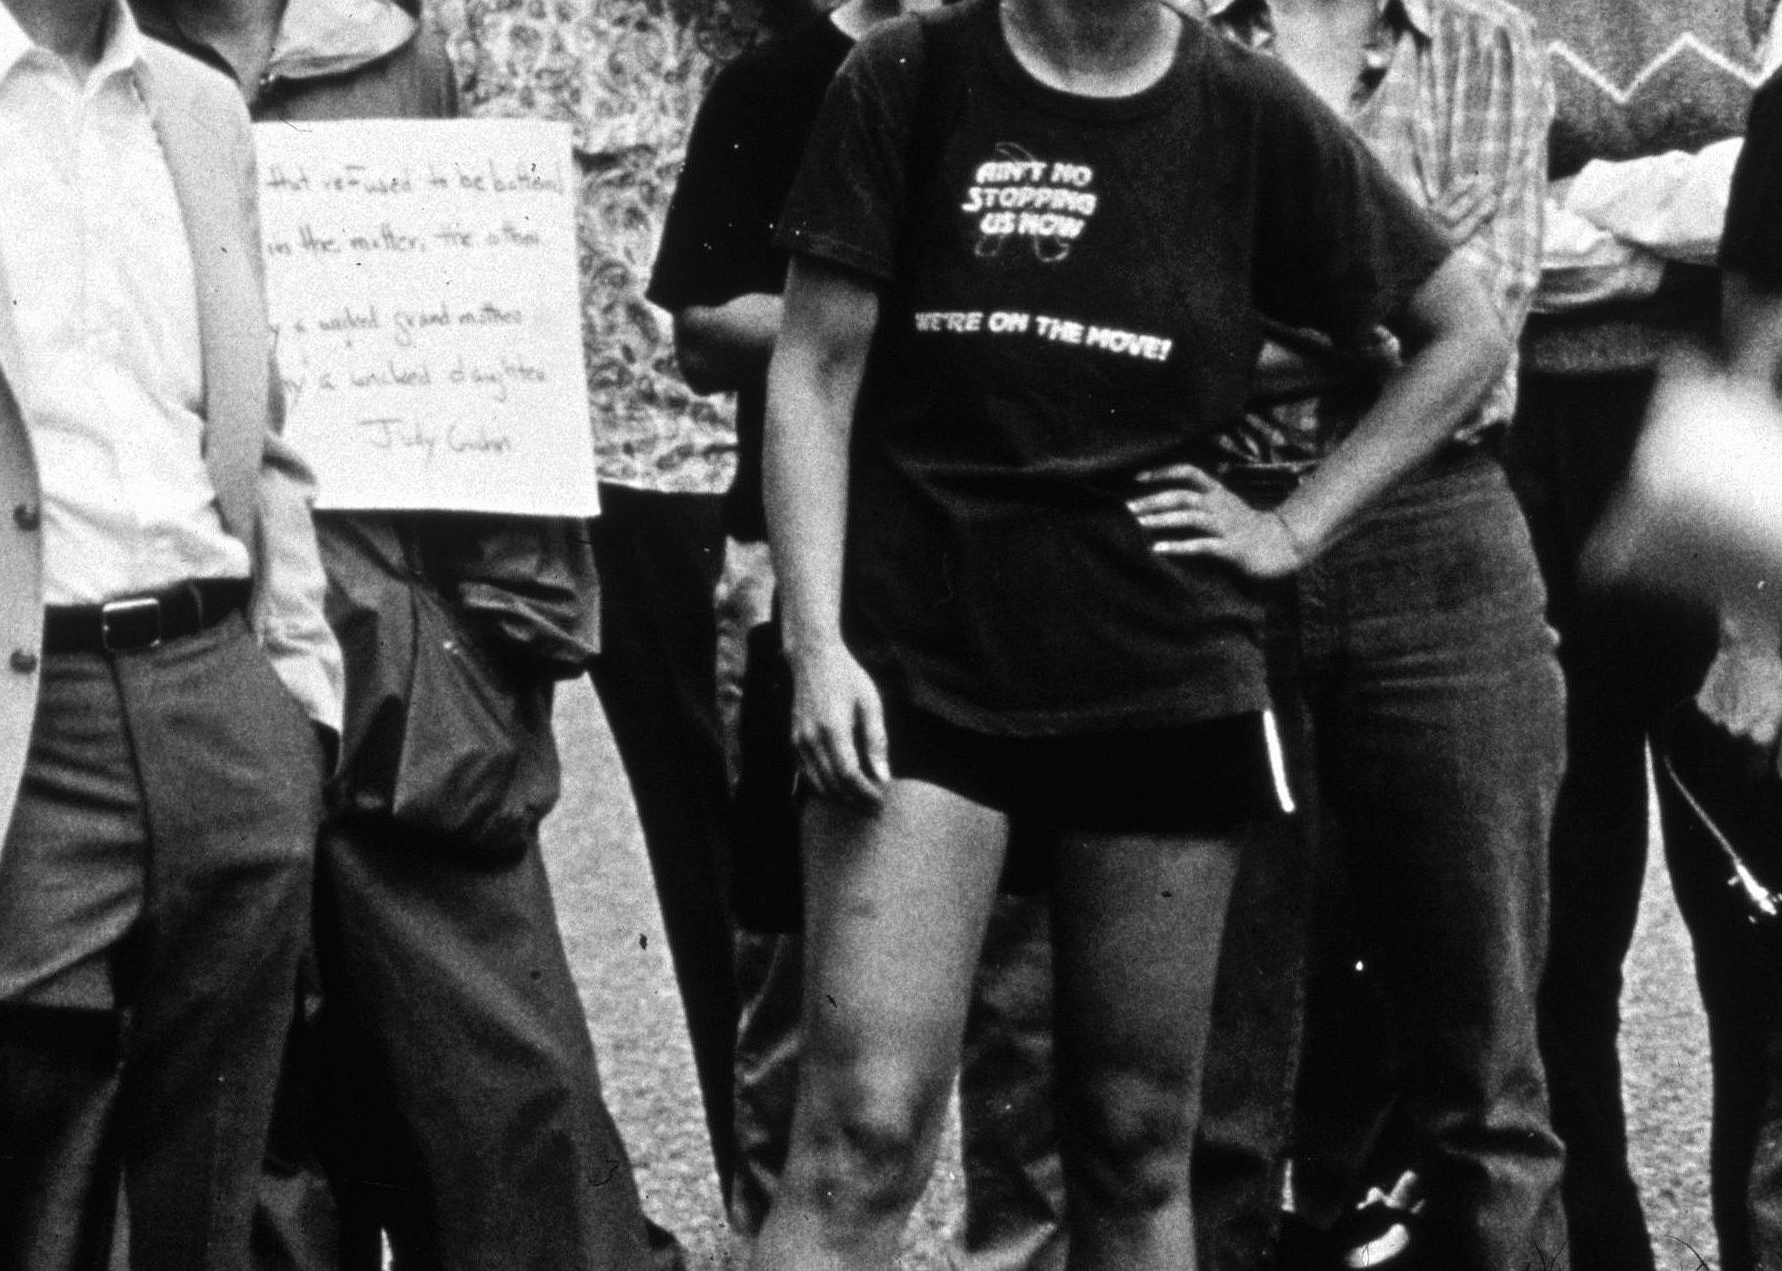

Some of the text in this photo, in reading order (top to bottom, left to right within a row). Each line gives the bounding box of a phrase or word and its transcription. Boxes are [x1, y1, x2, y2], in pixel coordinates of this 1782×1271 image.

[1051, 163, 1093, 187] NO
[961, 186, 1097, 216] STOPPING
[980, 212, 1085, 238] US NOW
[988, 312, 1029, 332] ON
[1035, 315, 1084, 344] THE
[1086, 327, 1172, 362] MOVE!
